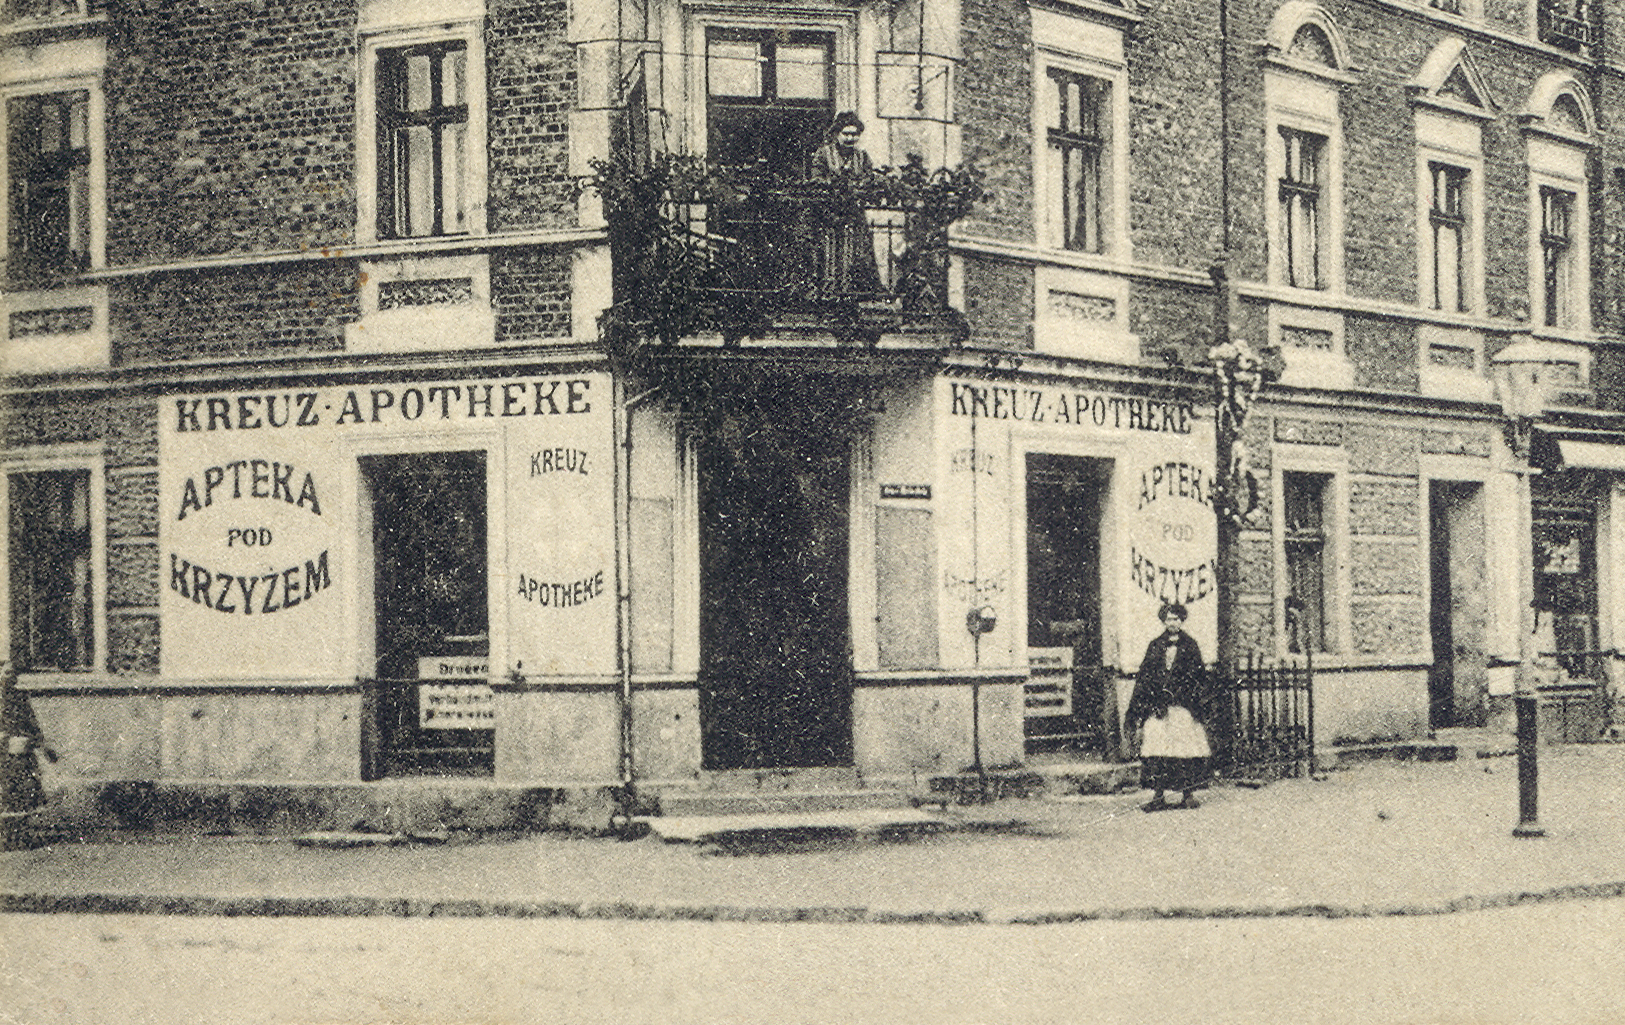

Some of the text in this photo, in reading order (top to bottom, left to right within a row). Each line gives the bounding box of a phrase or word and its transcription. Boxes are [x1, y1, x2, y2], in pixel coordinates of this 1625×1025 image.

[177, 459, 323, 521] APTEKA
[227, 527, 273, 548] POD
[1162, 524, 1195, 543] POD
[170, 549, 332, 615] KRZYŻEM
[517, 569, 604, 609] APOTHEKE
